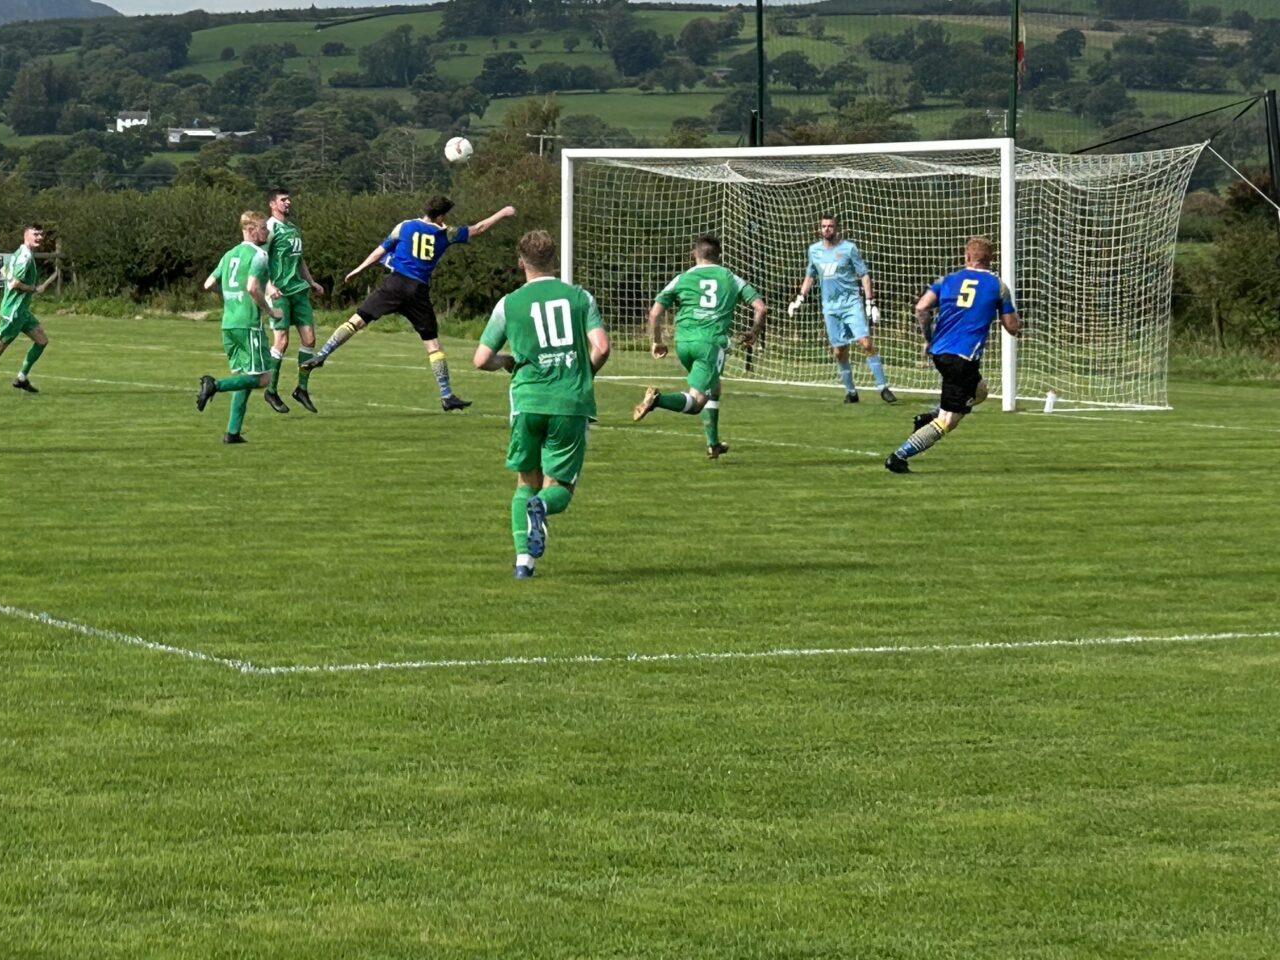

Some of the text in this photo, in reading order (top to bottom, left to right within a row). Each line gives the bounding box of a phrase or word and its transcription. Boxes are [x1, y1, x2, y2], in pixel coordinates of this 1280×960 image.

[412, 231, 436, 260] 16
[228, 257, 241, 288] 2
[699, 279, 718, 308] 3
[956, 279, 979, 308] 5
[530, 298, 574, 348] 10
